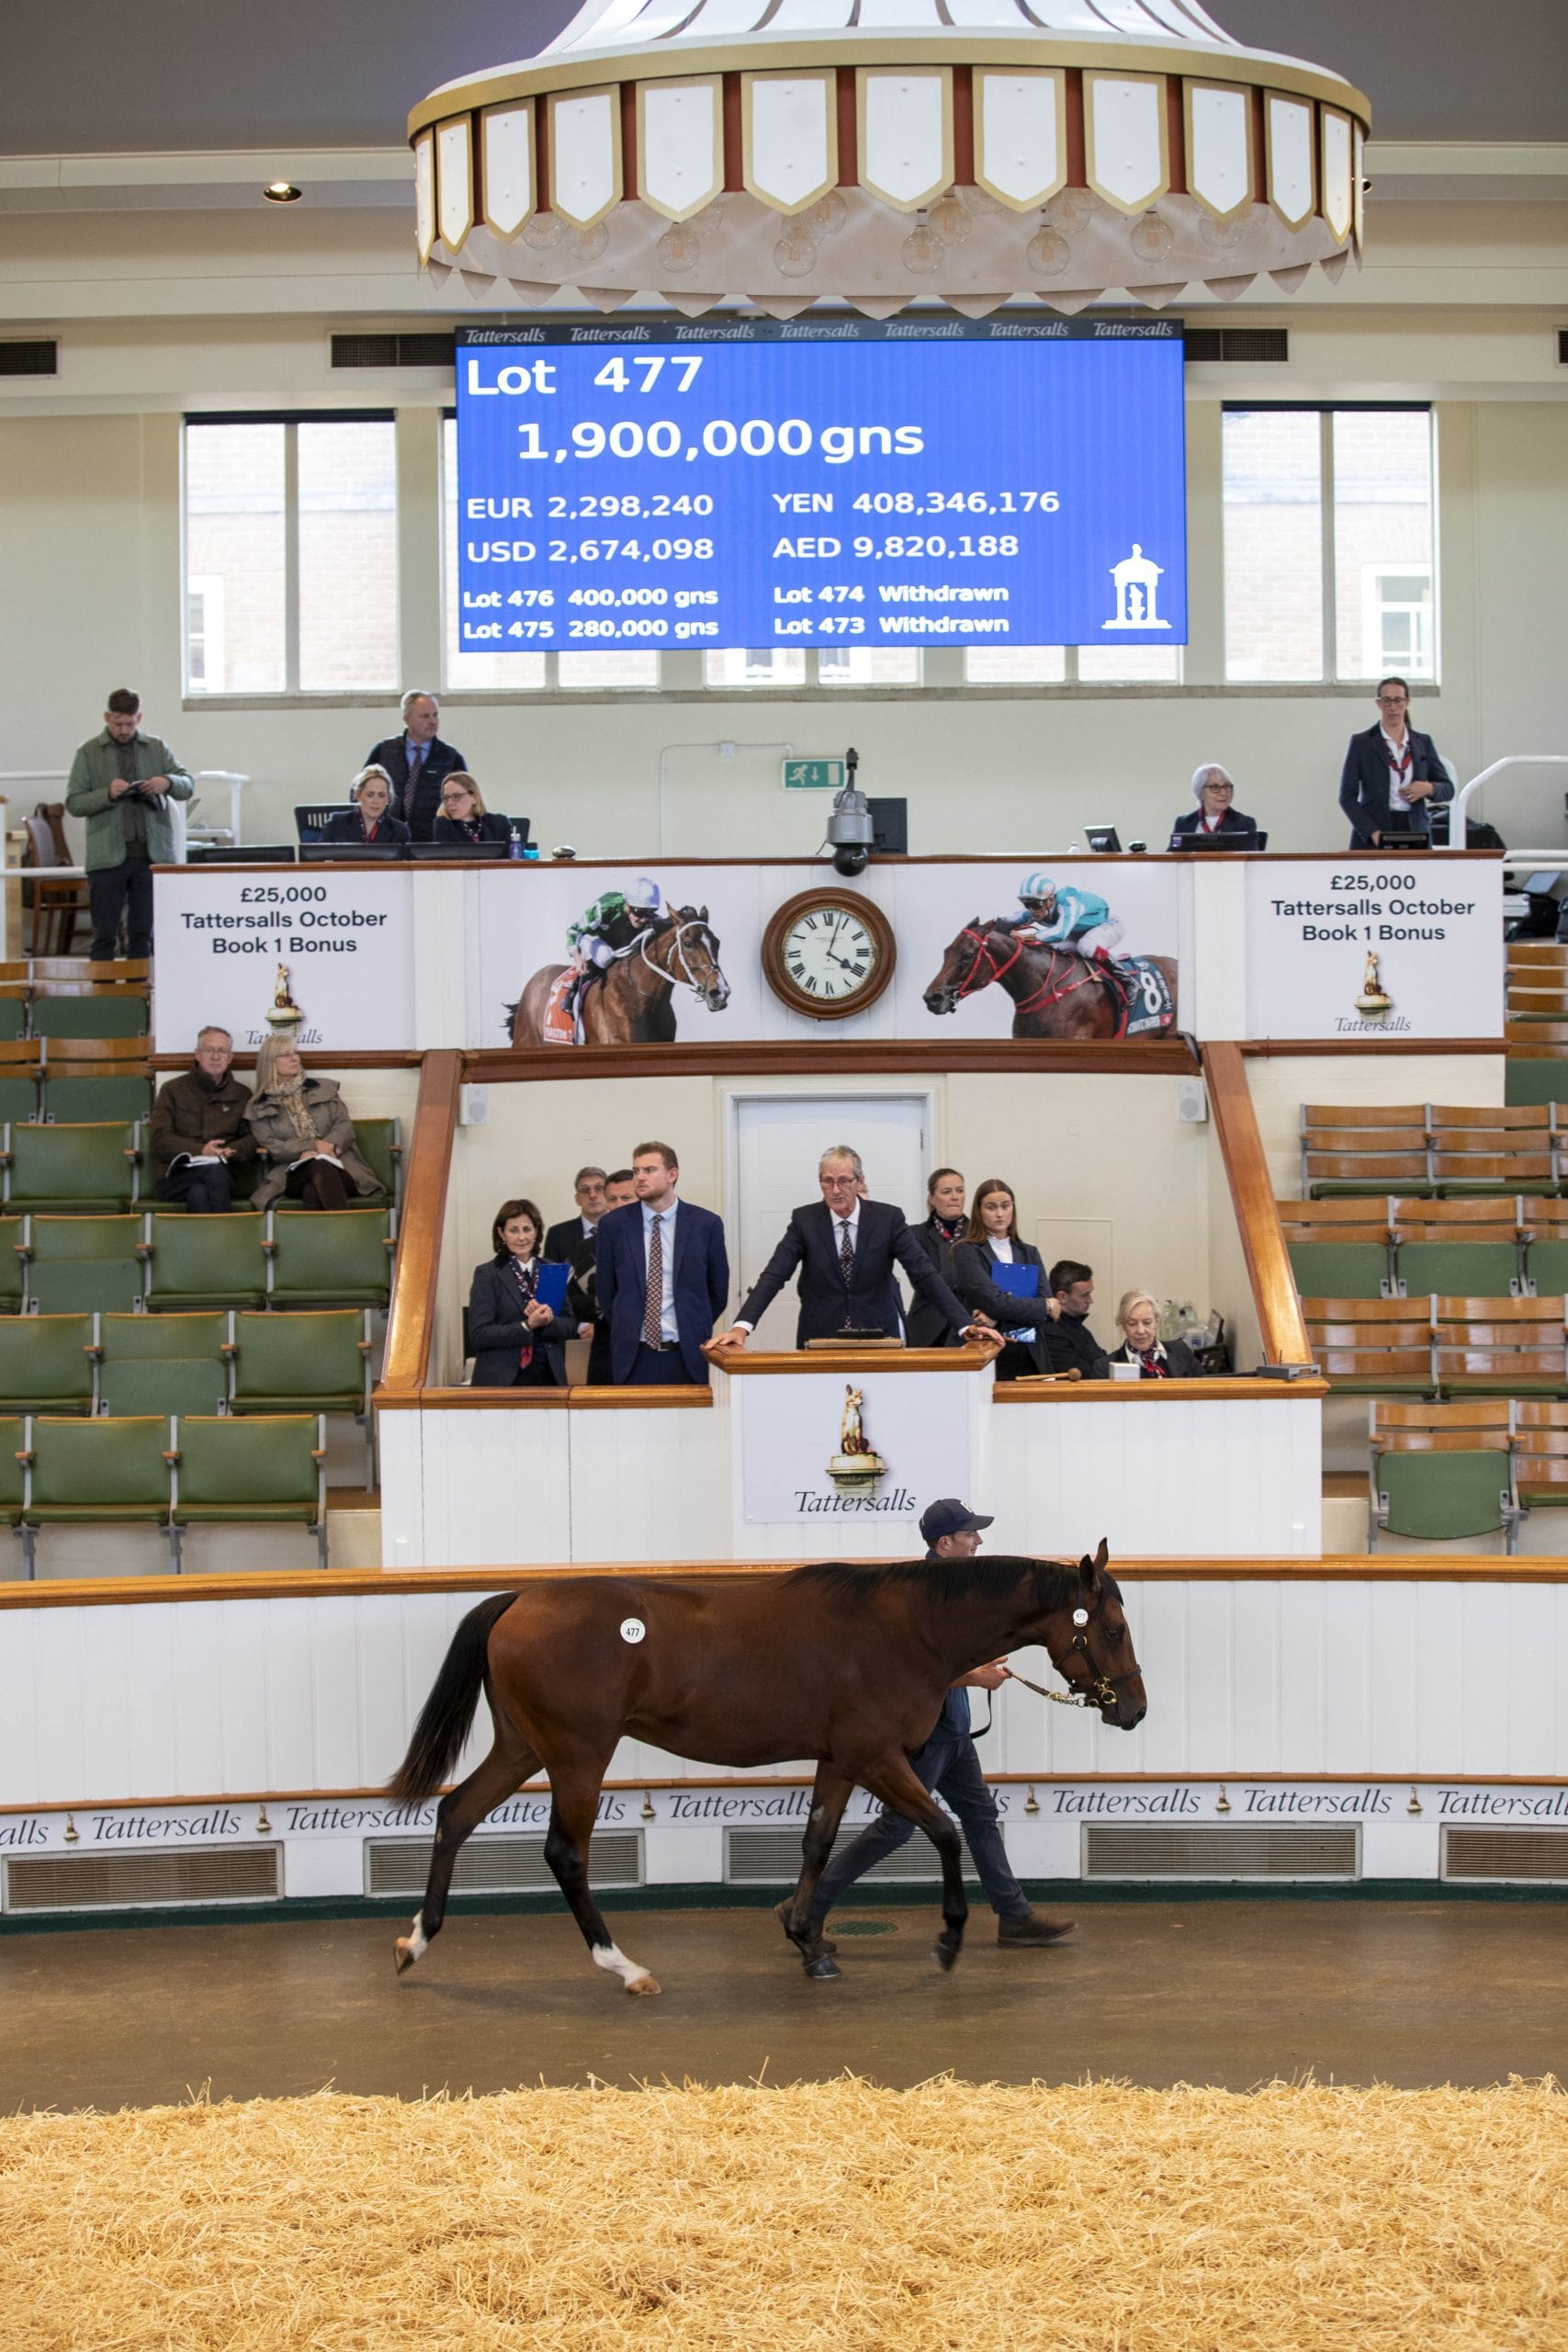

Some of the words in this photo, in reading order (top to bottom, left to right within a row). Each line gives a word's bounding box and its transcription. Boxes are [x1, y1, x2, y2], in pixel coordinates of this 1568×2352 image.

[466, 328, 546, 344] Tattersalls
[570, 326, 650, 342] Tattersalls
[675, 324, 755, 340] Tattersalls
[780, 323, 860, 339] Tattersalls
[885, 322, 964, 338] Tattersalls
[989, 322, 1069, 337] Tattersalls
[1094, 322, 1173, 337] Tattersalls
[468, 359, 557, 395] Lot
[593, 356, 704, 393] 477
[518, 419, 813, 464] 1,900,000
[820, 425, 924, 464] gns
[467, 497, 534, 520] EUR
[547, 494, 714, 521] 2,298,240
[772, 492, 834, 513] YEN
[852, 491, 1061, 515] 408,346,176
[467, 540, 536, 563] USD
[547, 537, 715, 564] 2,674,098
[772, 537, 842, 559] AED
[852, 535, 1020, 560] 9,820,188
[463, 591, 502, 608] Lot
[506, 589, 555, 607] 476
[567, 587, 669, 608] 400,000
[673, 590, 719, 609] gns
[773, 586, 813, 604] Lot
[817, 585, 865, 603] 474
[878, 584, 1010, 604] Withdrawn
[463, 622, 502, 639] Lot
[506, 620, 555, 639] 475
[568, 618, 669, 639] 280,000
[673, 621, 719, 640] gns
[773, 617, 814, 635] Lot
[817, 616, 865, 634] 473
[878, 616, 1010, 634] Withdrawn
[1330, 875, 1416, 892] £25,000
[240, 886, 327, 904] £25,000
[1270, 899, 1382, 916] Tattersalls
[1388, 899, 1475, 915] October
[180, 911, 293, 929] Tattersalls
[299, 910, 388, 928] October
[1303, 924, 1358, 941] Book
[1363, 925, 1371, 941] 1
[1379, 924, 1446, 941] Bonus
[212, 936, 268, 954] Book
[274, 937, 282, 953] 1
[289, 936, 357, 953] Bonus
[1140, 970, 1163, 1015] 8
[1334, 1016, 1412, 1033] Tattersalls
[244, 1028, 323, 1045] Taalls
[794, 1488, 918, 1513] Tattersalls
[626, 1627, 640, 1637] 477
[92, 1807, 241, 1840] Tattersalls
[286, 1798, 435, 1831] Tattersalls
[1052, 1787, 1201, 1815] Tattersalls
[1243, 1788, 1393, 1815] Tattersalls
[1437, 1790, 1568, 1816] Tattersal
